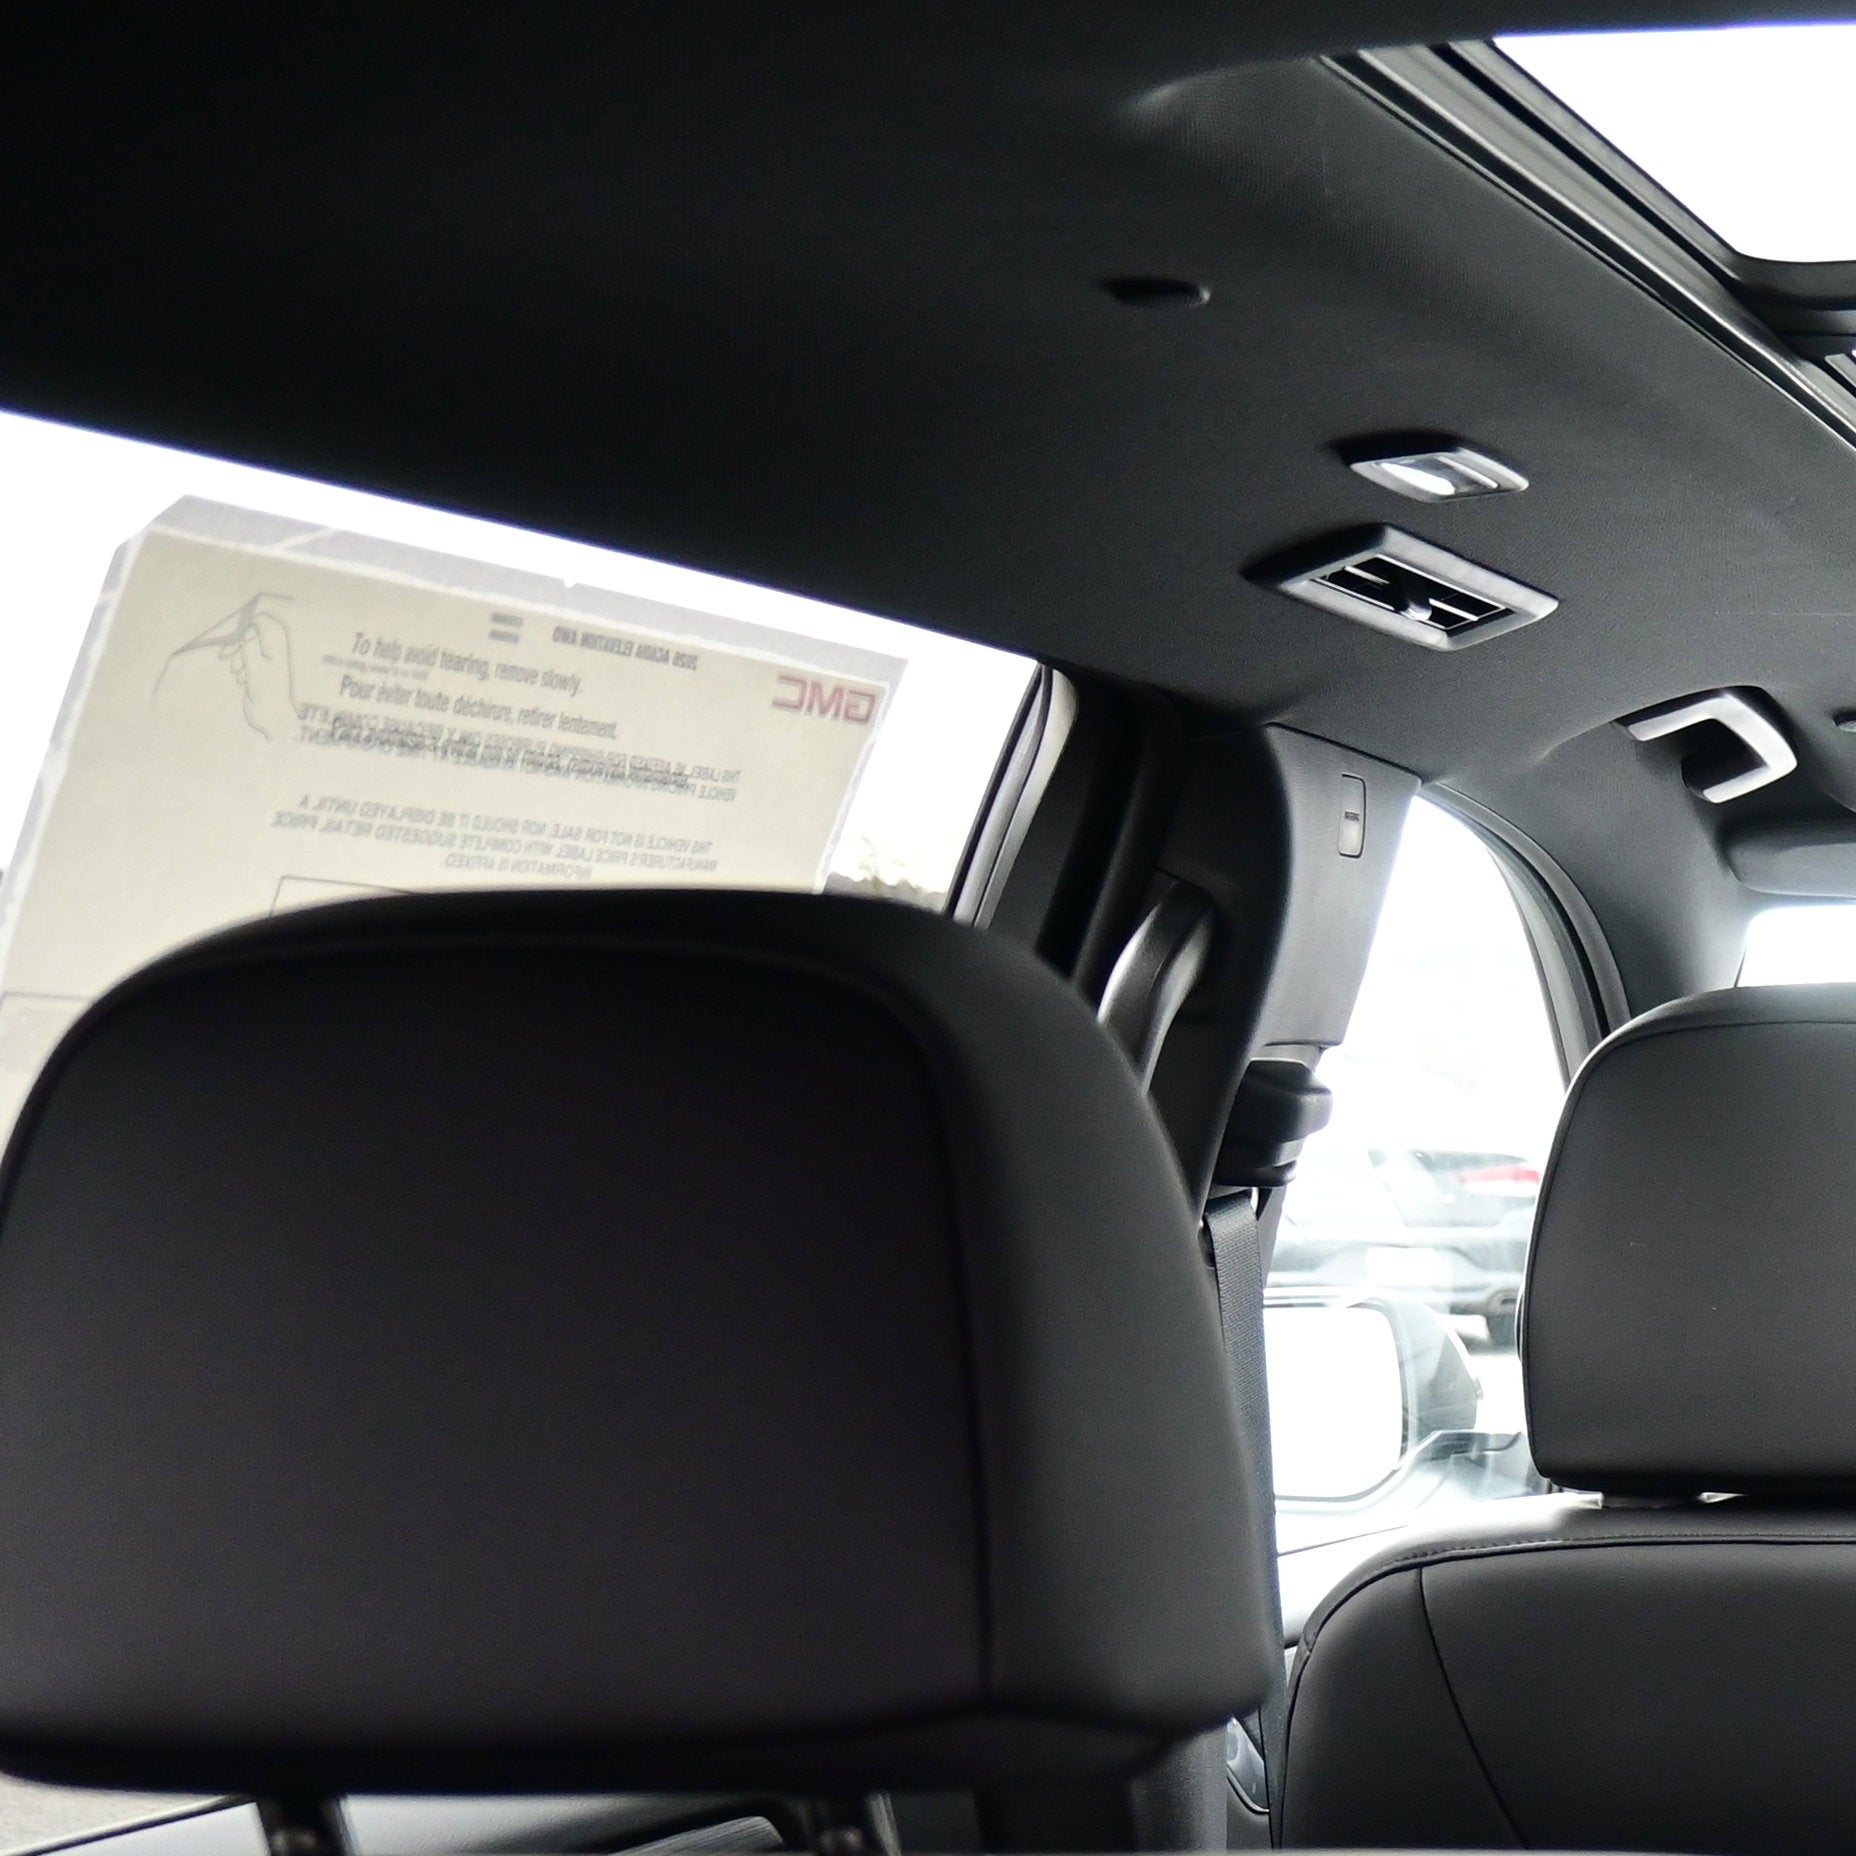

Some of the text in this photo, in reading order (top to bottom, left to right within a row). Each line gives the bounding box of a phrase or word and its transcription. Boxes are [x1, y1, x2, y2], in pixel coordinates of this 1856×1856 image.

[352, 631, 371, 656] To
[373, 635, 402, 663] help
[403, 643, 440, 667] avoid
[495, 662, 538, 685] remove
[340, 673, 376, 700] Pour
[414, 689, 449, 713] toute
[518, 705, 556, 729] retirer
